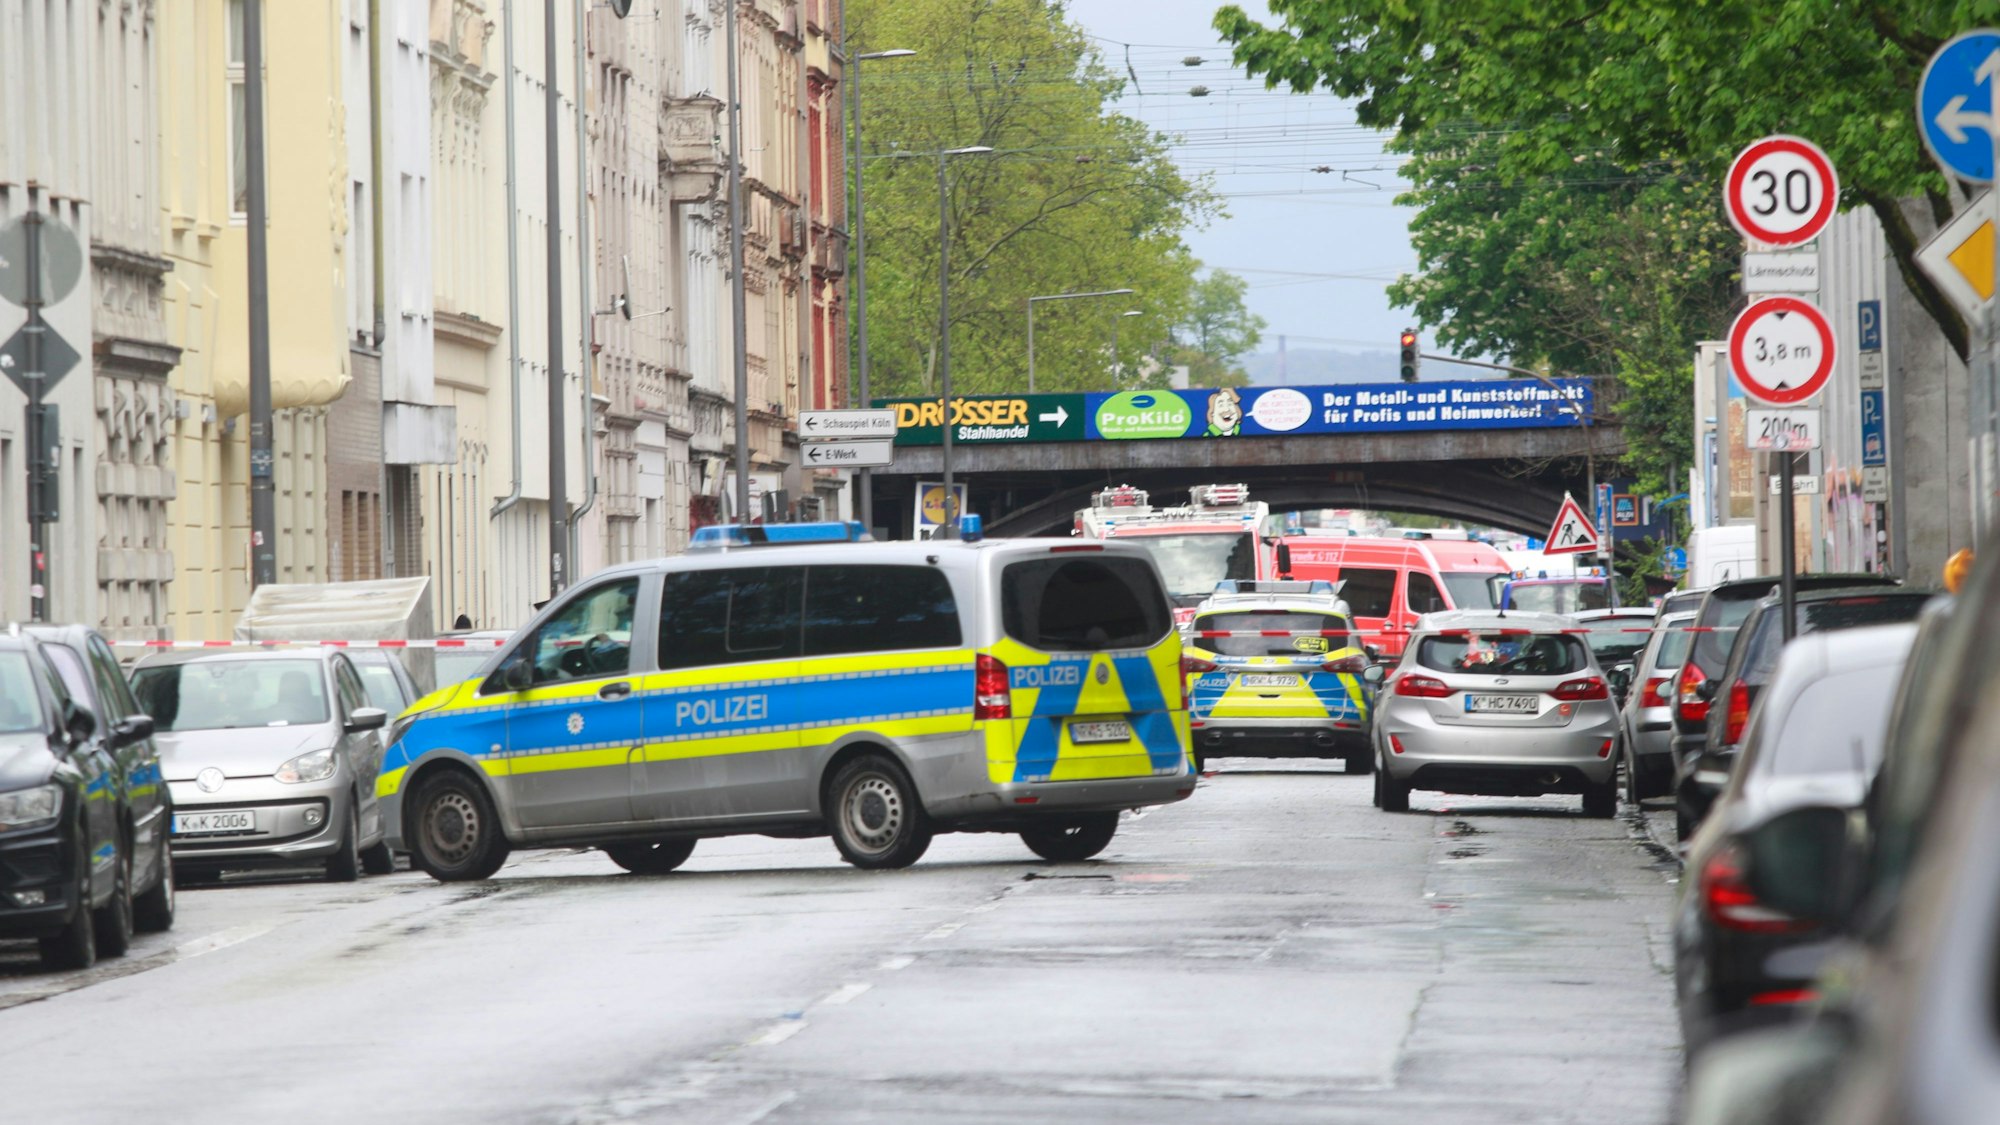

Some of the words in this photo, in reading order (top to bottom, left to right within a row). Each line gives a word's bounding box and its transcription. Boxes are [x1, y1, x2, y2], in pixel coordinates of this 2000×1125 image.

[1751, 169, 1811, 216] 30
[1748, 265, 1816, 278] Lärmschutz
[1755, 336, 1788, 365] 3,8
[1794, 345, 1811, 359] m
[1323, 392, 1352, 407] Der
[1356, 390, 1409, 406] Metall-
[1417, 389, 1447, 404] und
[1451, 386, 1584, 403] Kunststoffmarkt
[896, 398, 1029, 428] DRÖSSER
[1101, 411, 1184, 426] ProKilo
[1324, 409, 1349, 424] für
[1353, 408, 1401, 423] Profis
[1406, 407, 1436, 422] und
[1441, 404, 1542, 420] Heimwerker!
[823, 418, 869, 430] Schauspiel
[872, 417, 891, 428] Köln
[958, 425, 1029, 440] Stahlhandel
[825, 449, 857, 460] E-Werk
[1014, 665, 1080, 687] POLIZEI
[675, 694, 768, 727] POLIZEI
[1472, 698, 1481, 708] K
[1488, 698, 1504, 708] HC
[1507, 698, 1537, 709] 7490
[181, 817, 191, 829] K
[200, 816, 209, 828] K
[212, 814, 248, 828] 2006
